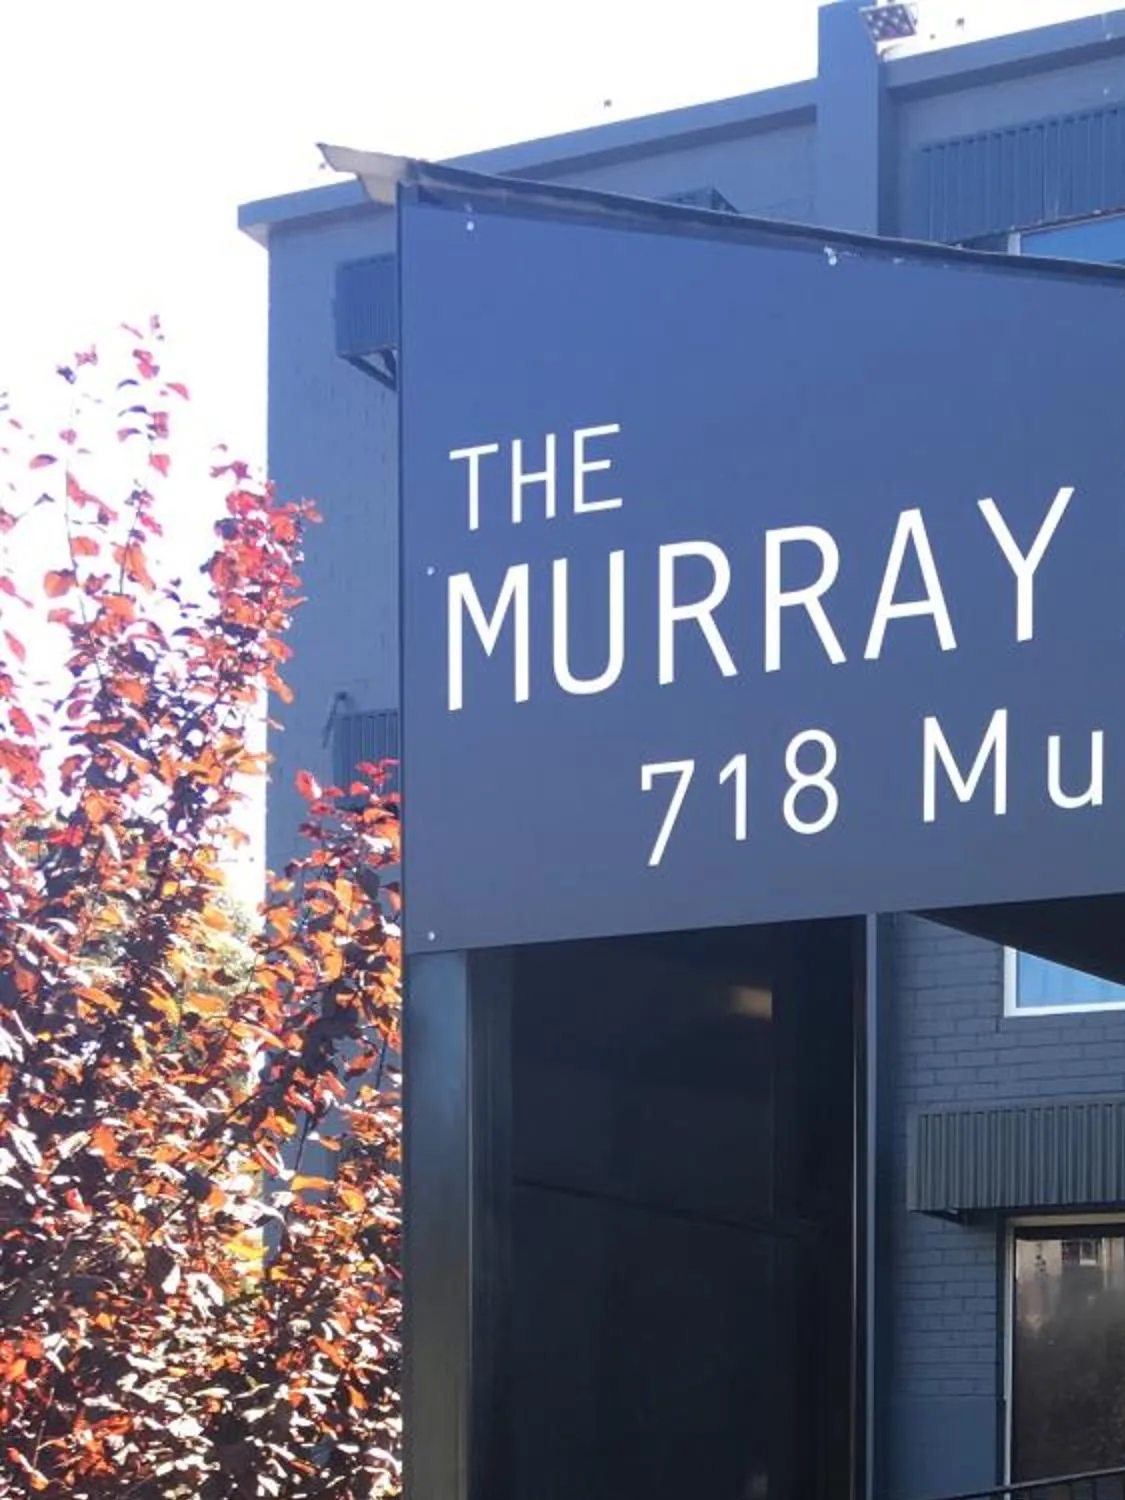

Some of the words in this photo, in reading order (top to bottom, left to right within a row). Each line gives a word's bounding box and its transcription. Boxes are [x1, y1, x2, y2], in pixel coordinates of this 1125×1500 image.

[448, 422, 623, 531] THE
[447, 486, 1075, 712] MURRAY
[640, 728, 839, 867] 718
